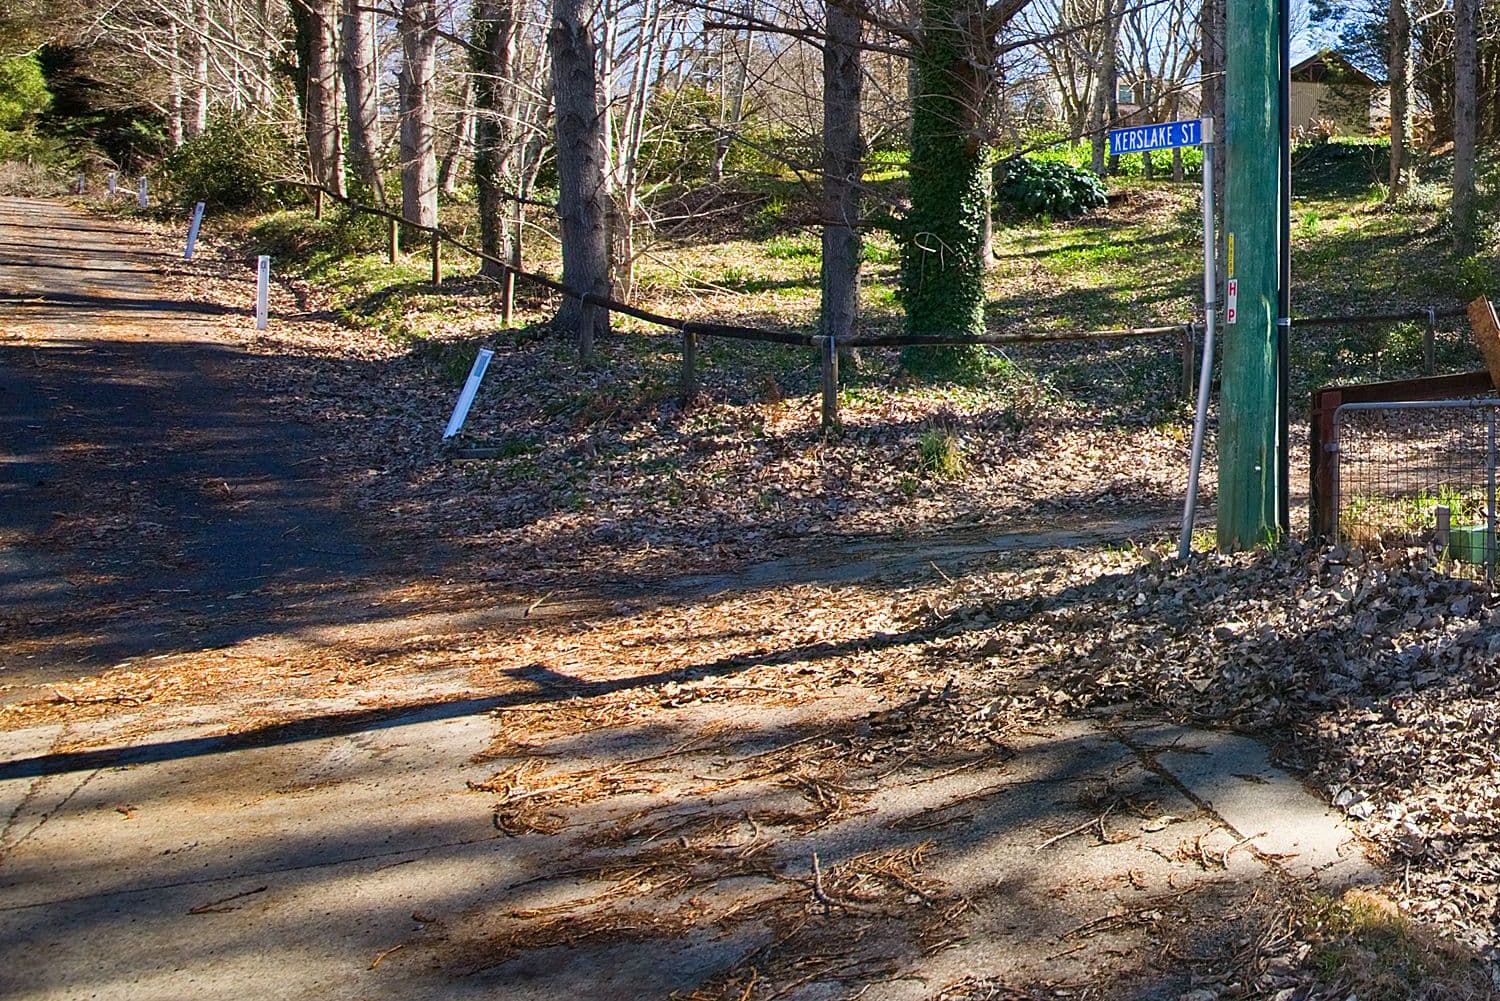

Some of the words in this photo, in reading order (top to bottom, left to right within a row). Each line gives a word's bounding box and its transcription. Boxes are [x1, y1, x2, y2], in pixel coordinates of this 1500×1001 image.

[1115, 126, 1173, 152] KERSLAKE
[1181, 123, 1195, 144] ST
[1229, 282, 1237, 297] H
